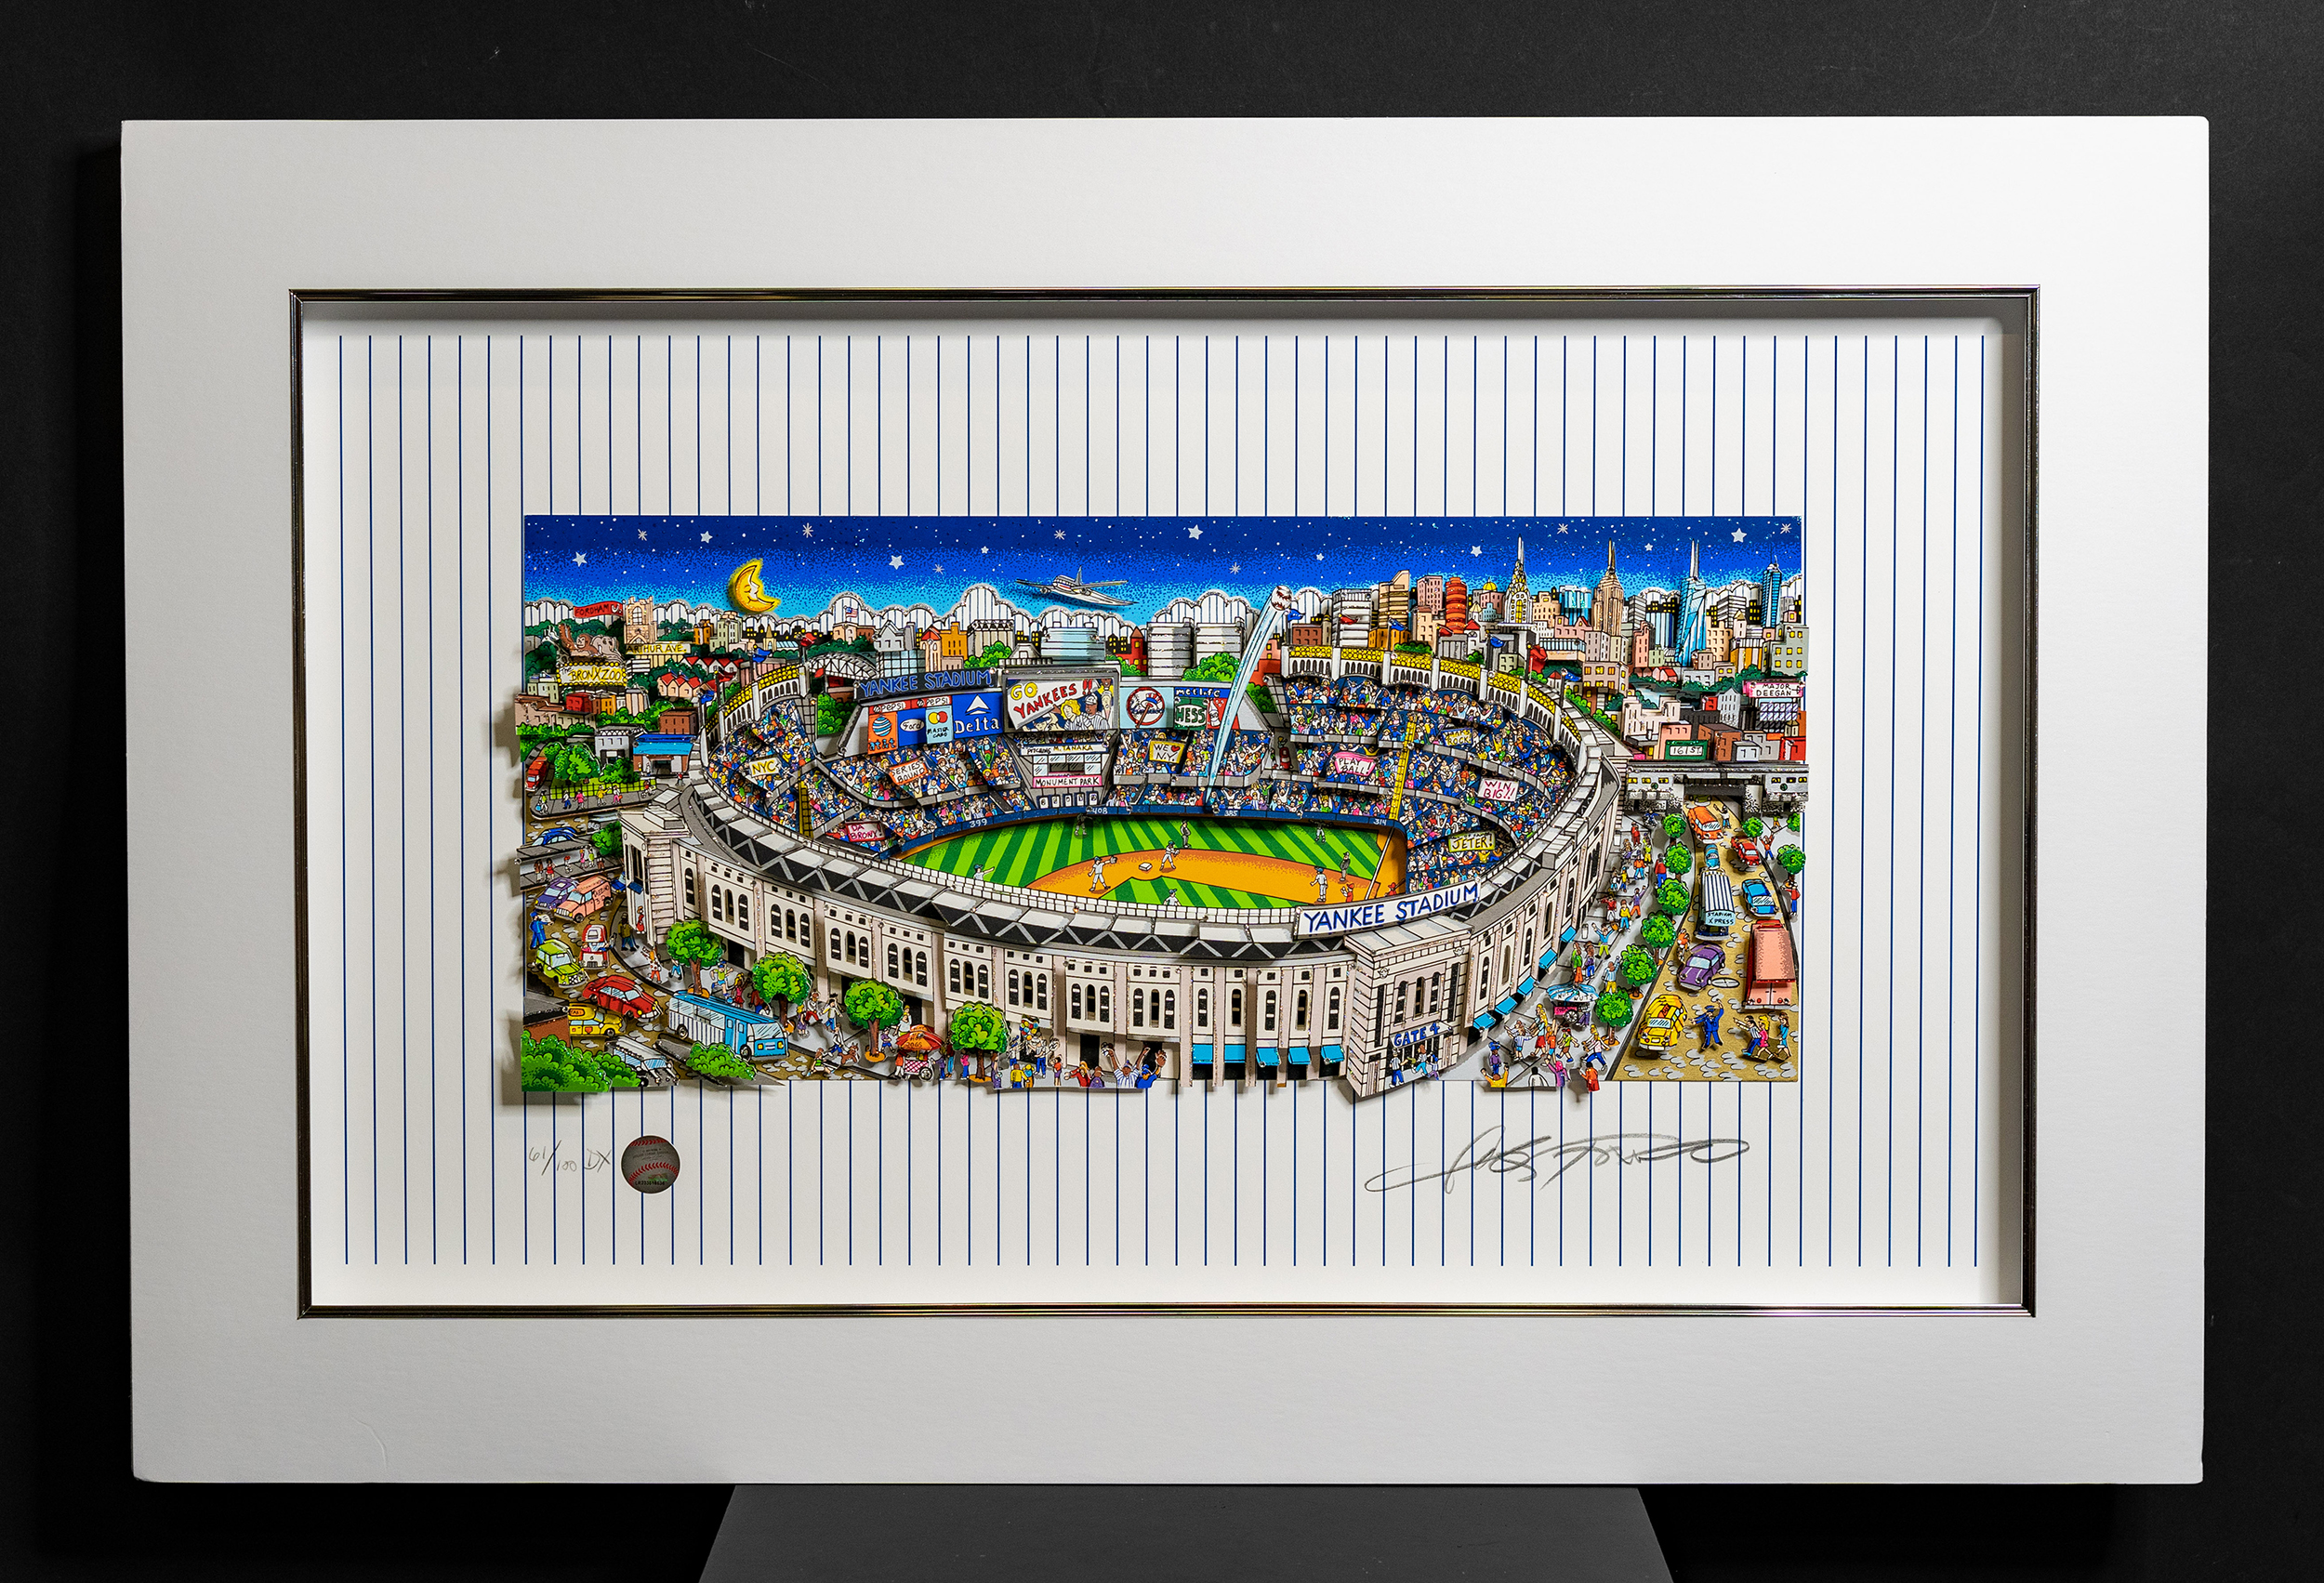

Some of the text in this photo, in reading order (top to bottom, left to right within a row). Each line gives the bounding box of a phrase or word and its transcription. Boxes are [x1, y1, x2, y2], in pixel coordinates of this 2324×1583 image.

[574, 603, 610, 615] FORDHAM
[627, 643, 687, 653] ARTHUR AVE.
[860, 669, 992, 698] YANKEE STADIUM
[1010, 681, 1038, 700] GO
[1014, 683, 1076, 719] YANKEES
[1176, 706, 1206, 724] HESS
[903, 721, 923, 731] Ford
[955, 717, 999, 734] Delta
[752, 759, 776, 774] NYC
[892, 762, 921, 777] SERIES
[1036, 776, 1100, 786] MONUMENT PARK
[1485, 781, 1512, 789] WIN
[1483, 788, 1516, 799] BIG!!
[969, 818, 988, 828] 399
[1452, 833, 1493, 850] JETER!
[1303, 882, 1479, 932] YANKEE STADIUM
[1394, 1022, 1440, 1047] GATE 4
